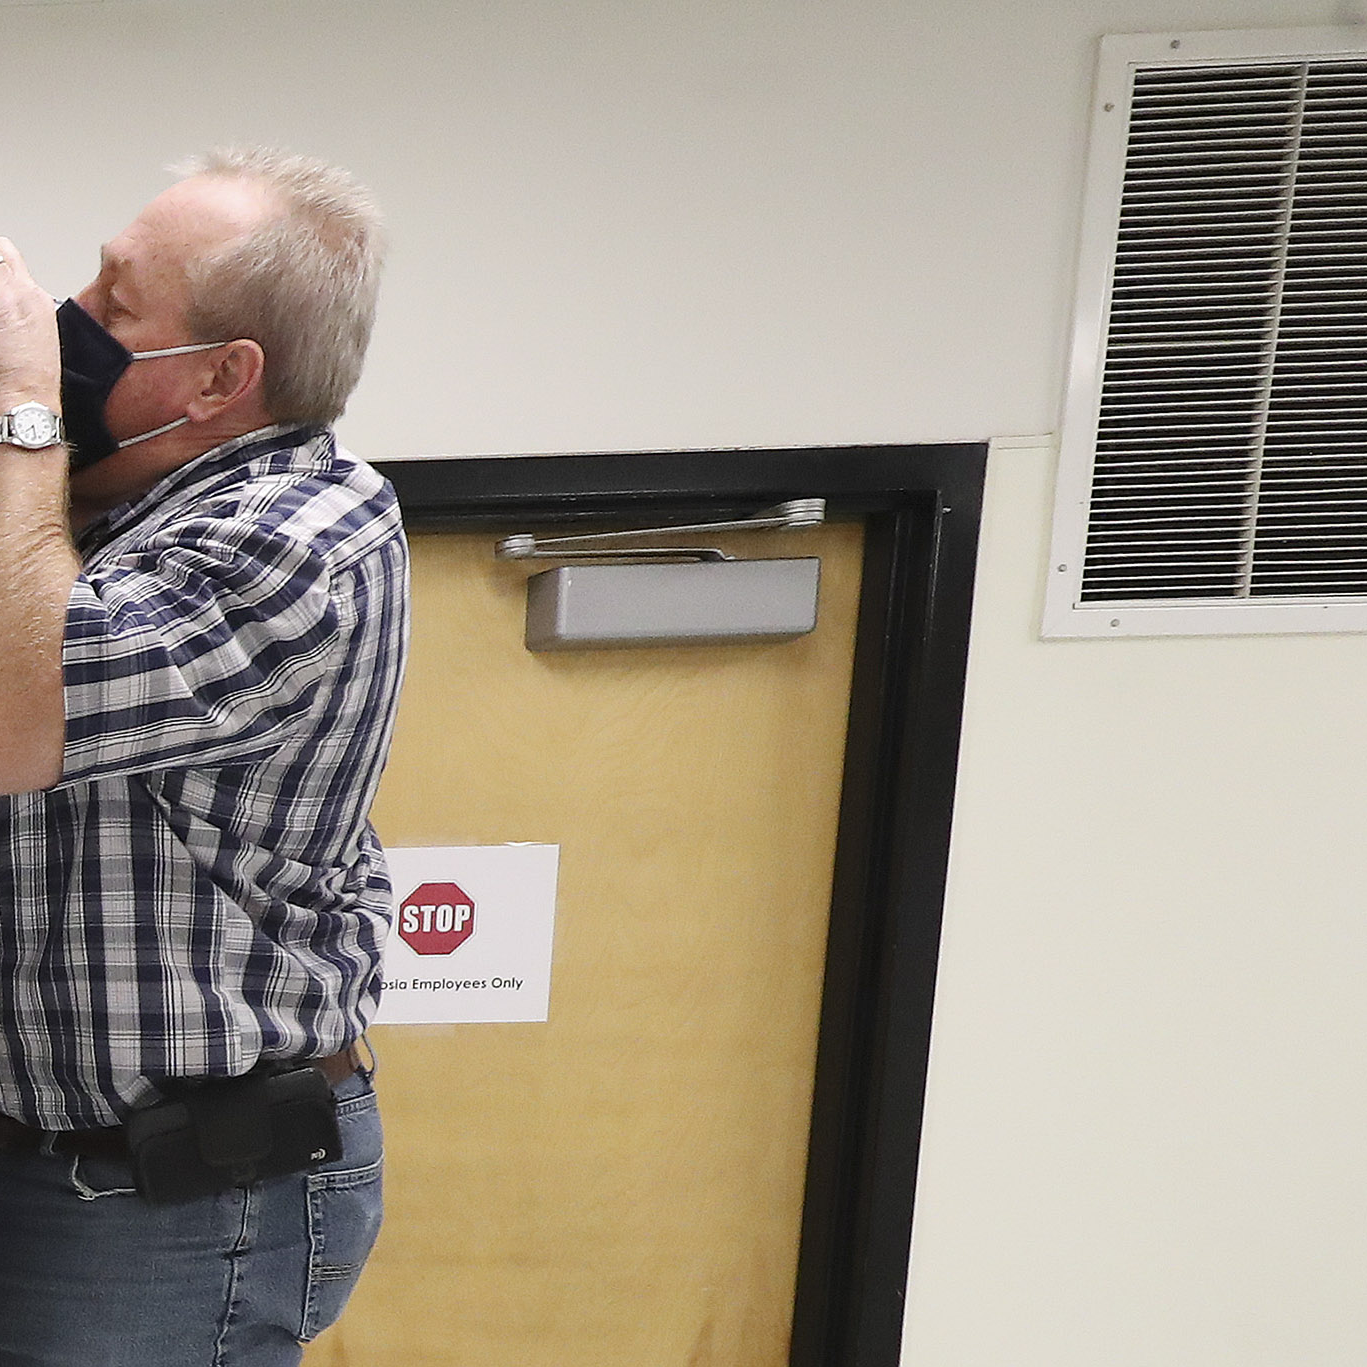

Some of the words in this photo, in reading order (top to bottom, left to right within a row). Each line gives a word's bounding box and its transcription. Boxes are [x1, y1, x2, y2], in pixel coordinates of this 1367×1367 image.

[402, 904, 471, 933] STOP
[380, 979, 407, 990] osia
[412, 978, 487, 992] Employees
[491, 977, 524, 991] Only
